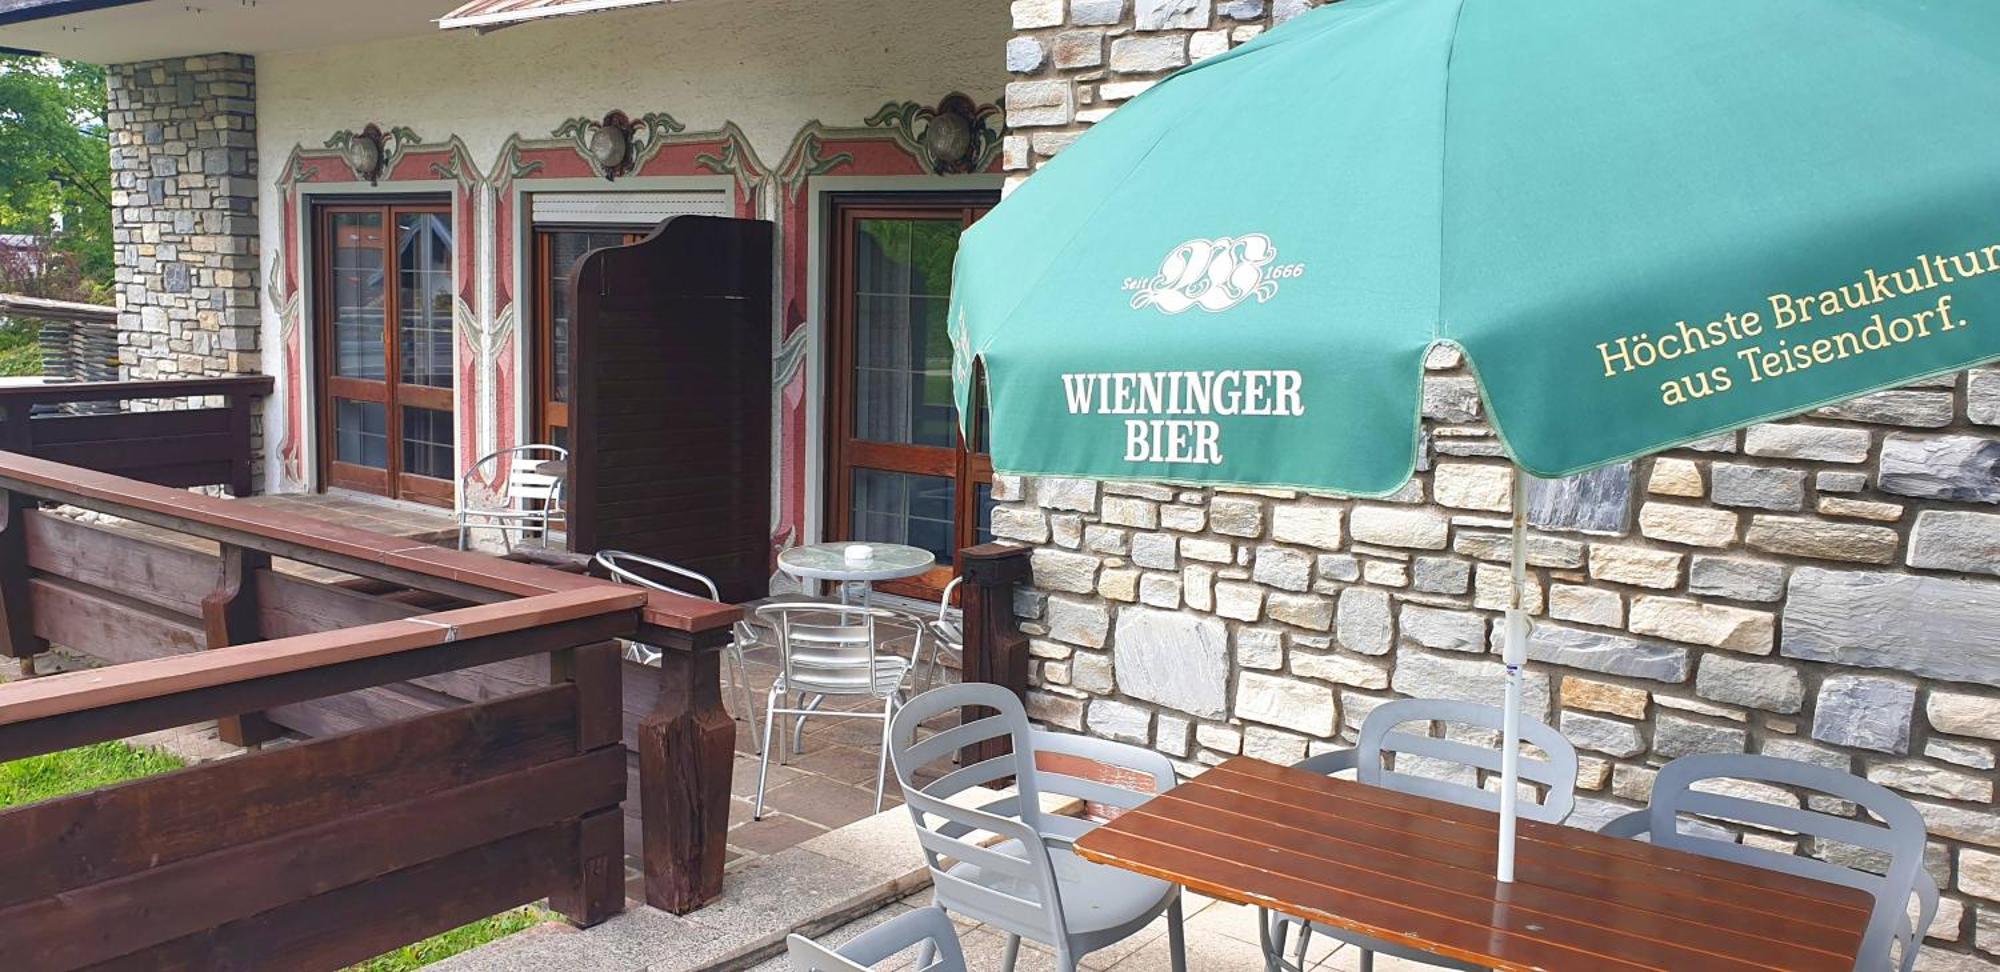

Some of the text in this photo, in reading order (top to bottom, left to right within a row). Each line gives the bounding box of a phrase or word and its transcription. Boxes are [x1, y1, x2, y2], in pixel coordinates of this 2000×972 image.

[1121, 263, 1305, 291] Seit 1666
[1596, 245, 2000, 377] Höchste Braukultur
[1659, 296, 1968, 406] aus Teisendorf.
[1062, 369, 1305, 417] WIENINGER
[1124, 419, 1223, 464] BIER
